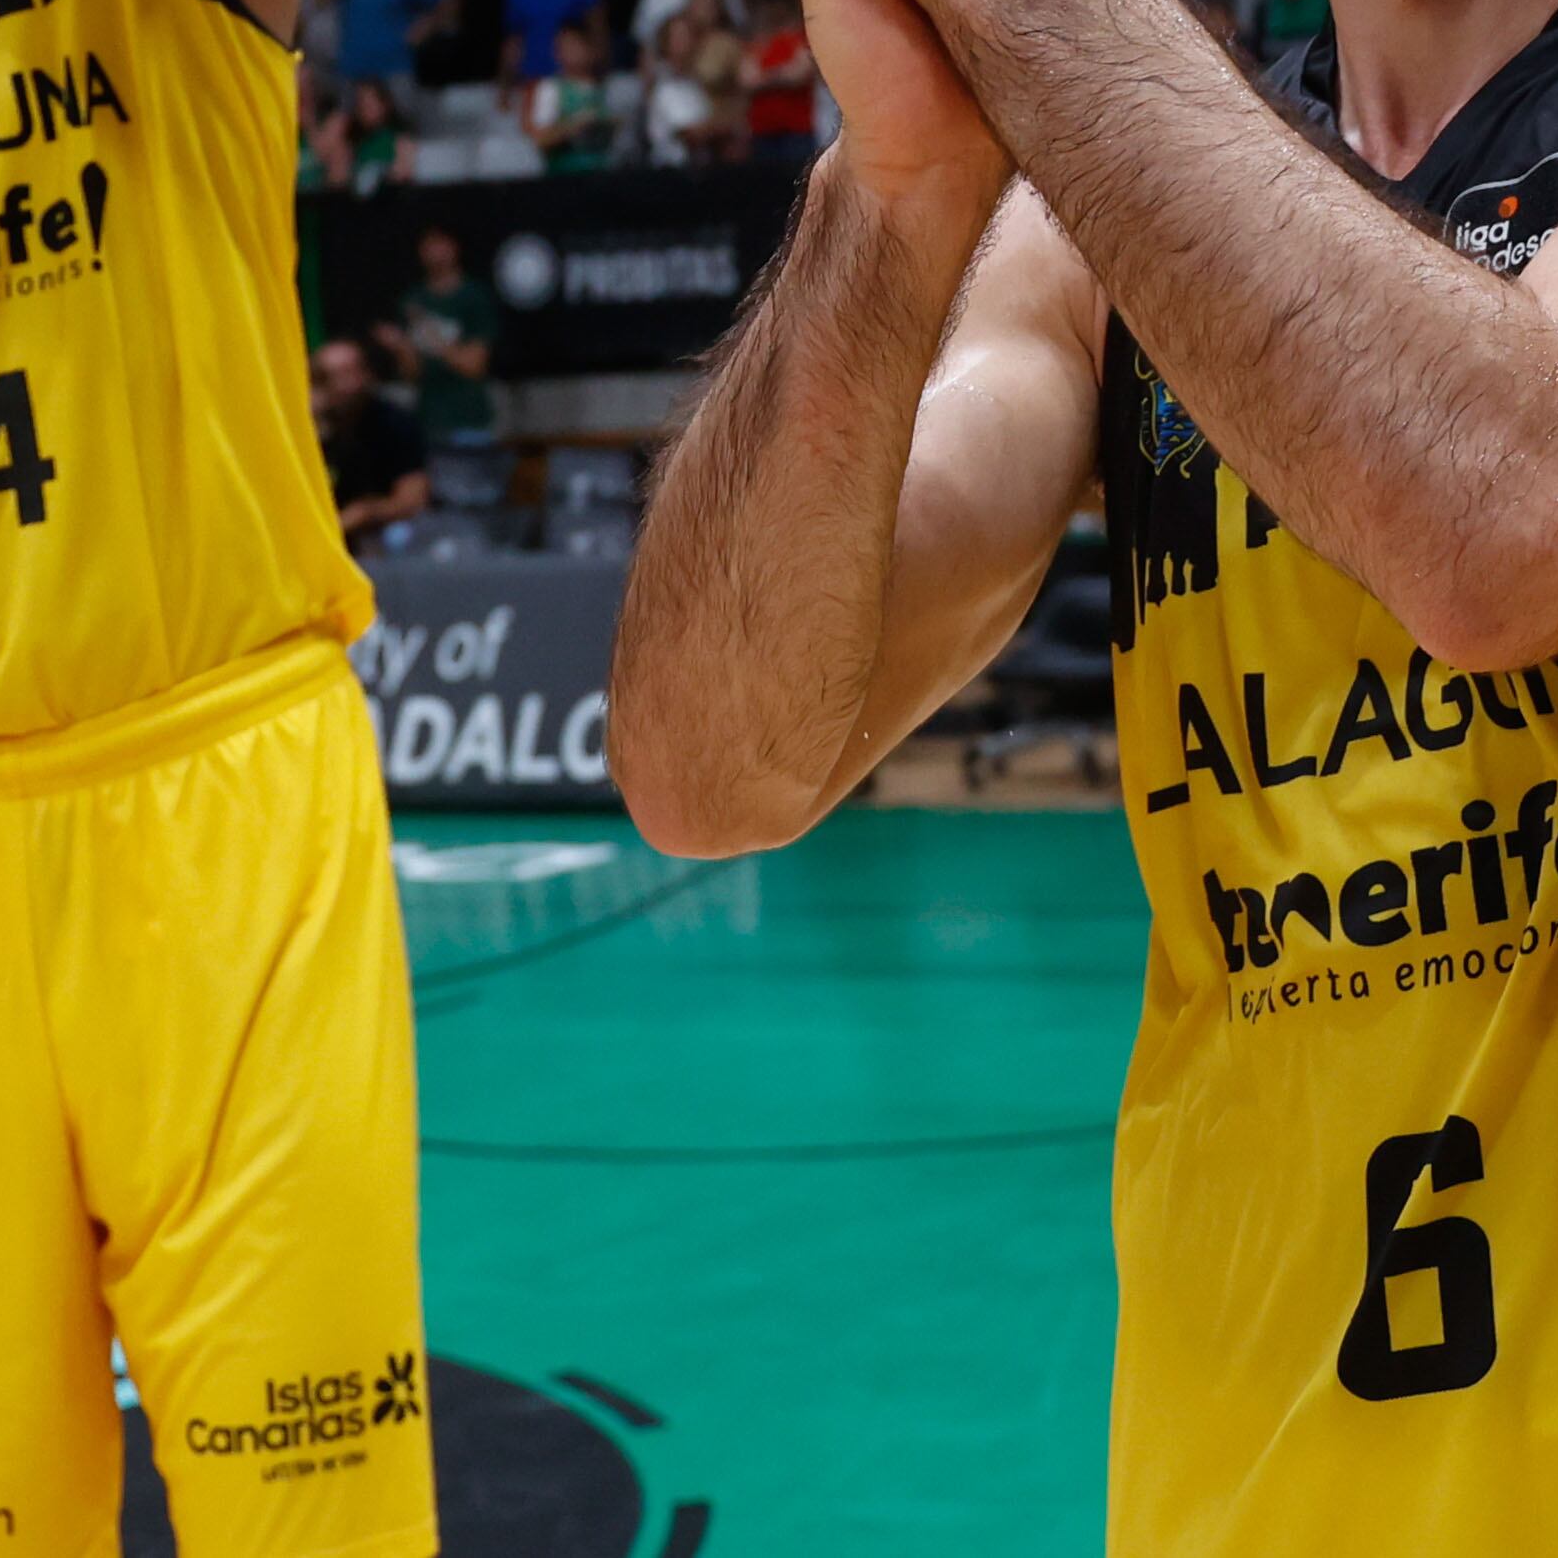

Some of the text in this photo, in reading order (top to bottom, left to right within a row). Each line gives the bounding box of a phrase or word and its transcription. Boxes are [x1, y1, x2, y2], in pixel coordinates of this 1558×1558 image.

[1454, 220, 1510, 253] liga
[1473, 227, 1556, 274] ndes
[433, 604, 515, 684] of
[1336, 1113, 1498, 1402] 6
[266, 1369, 364, 1415] Islas
[185, 1405, 366, 1455] Canarias
